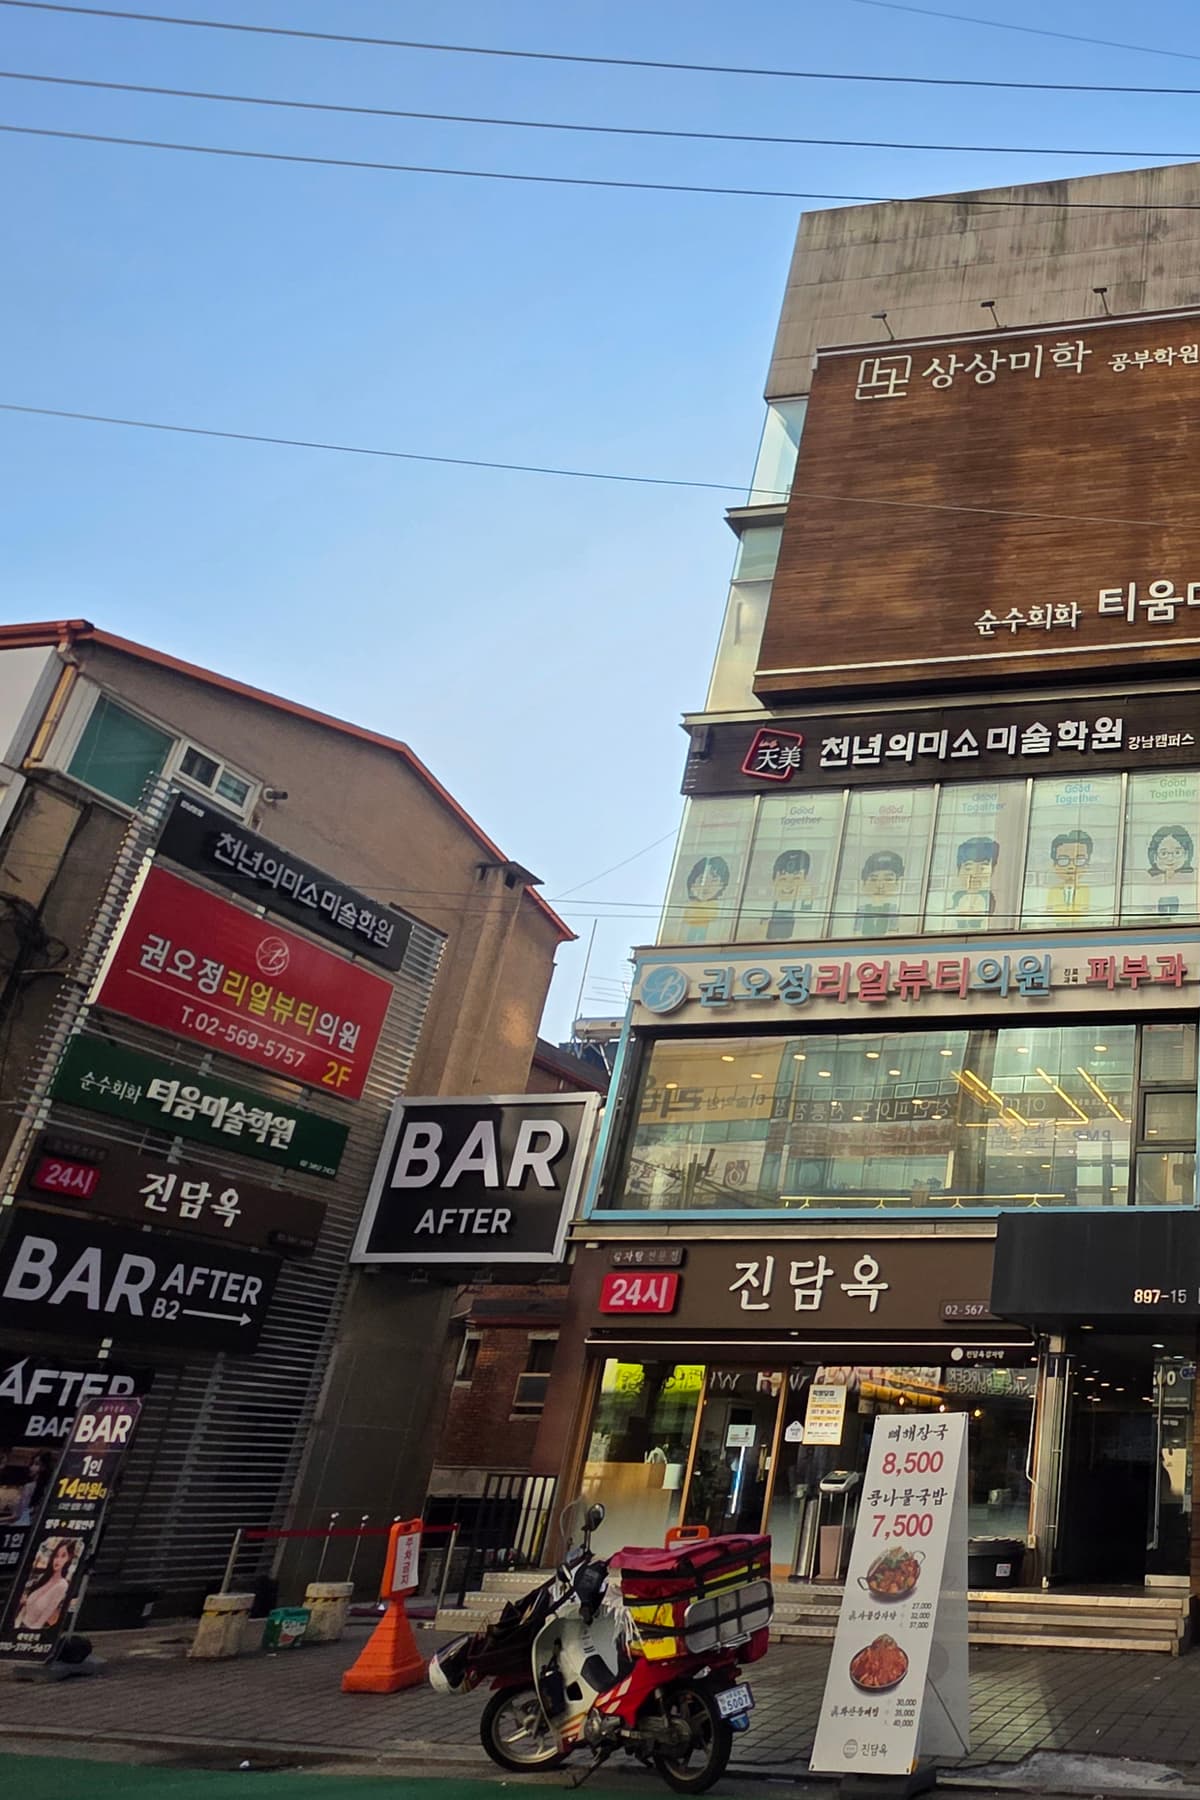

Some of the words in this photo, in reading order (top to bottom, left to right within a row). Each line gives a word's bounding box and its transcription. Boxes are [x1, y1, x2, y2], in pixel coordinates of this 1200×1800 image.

[921, 339, 1092, 389] 상상미학
[1108, 343, 1199, 372] 공부학원
[973, 601, 1081, 636] 순수회화
[1128, 732, 1195, 750] 강남캠퍼스
[214, 831, 395, 948] 천년의미소미술학원
[699, 953, 1052, 1008] 권오정리얼뷰티의원
[1086, 952, 1188, 991] 피부과
[139, 934, 361, 1054] 권오정리얼뷰티의원
[180, 1005, 306, 1068] T.02-569-5757
[322, 1061, 353, 1088] 2F
[80, 1071, 142, 1105] 순수회화
[146, 1078, 297, 1151] 티움미술학원
[390, 1119, 565, 1189] BAR
[44, 1163, 95, 1194] 24시
[138, 1172, 242, 1228] 진담옥
[413, 1208, 512, 1234] AFTER
[2, 1234, 156, 1317] BAR
[160, 1263, 263, 1305] AFTER
[728, 1254, 889, 1313] 진담옥
[151, 1298, 180, 1320] B2
[608, 1277, 669, 1309] 24시
[1133, 1289, 1187, 1304] 897-15
[74, 1414, 133, 1443] BAR
[887, 1423, 948, 1442] 뼈해장국
[81, 1455, 103, 1477] 1인
[882, 1451, 944, 1477] 8,500
[867, 1487, 948, 1507] 콩나물국밥
[872, 1513, 933, 1540] 7,500
